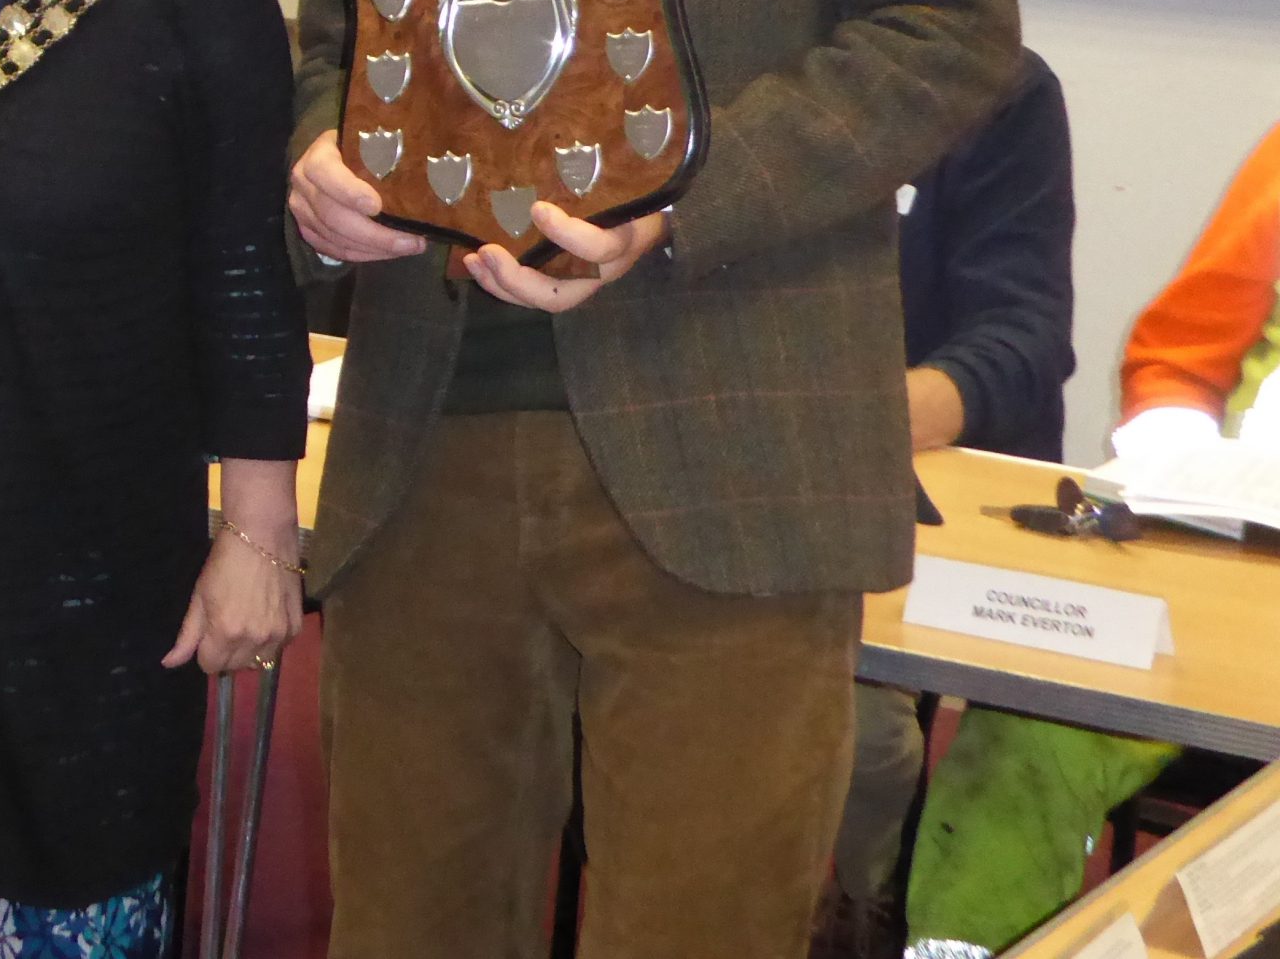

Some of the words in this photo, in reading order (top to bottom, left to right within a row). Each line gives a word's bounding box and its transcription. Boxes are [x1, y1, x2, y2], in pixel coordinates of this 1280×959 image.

[986, 589, 1088, 619] COUNCILLOR
[972, 604, 1016, 625] MARK
[1020, 613, 1095, 638] EVERTON
